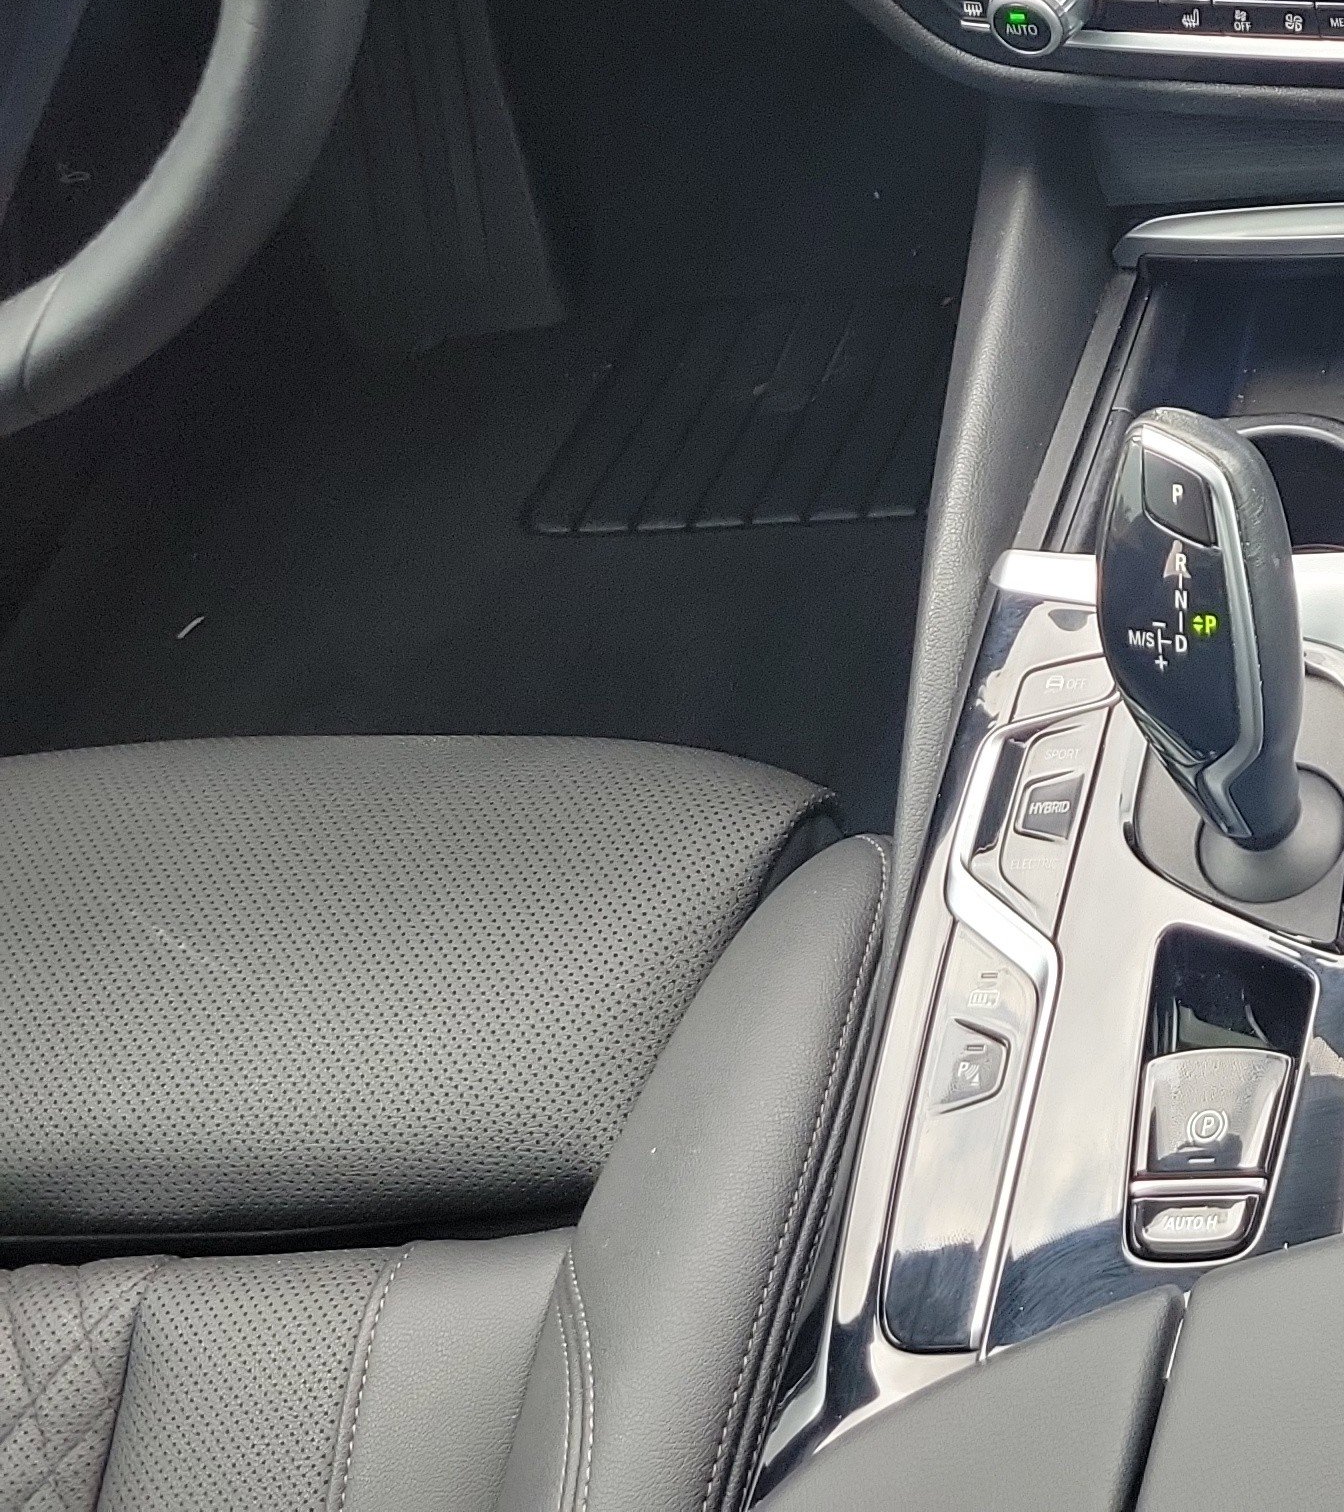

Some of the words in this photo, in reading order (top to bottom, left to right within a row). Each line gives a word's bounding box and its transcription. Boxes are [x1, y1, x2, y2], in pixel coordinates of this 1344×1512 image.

[1006, 23, 1038, 37] AUTO
[1233, 20, 1252, 32] OFF
[1172, 483, 1184, 506] P
[1175, 552, 1188, 574] R
[1174, 589, 1188, 611] N
[1205, 614, 1218, 637] P
[1127, 628, 1155, 649] M/S
[1175, 634, 1188, 654] D
[1066, 677, 1087, 689] OFF
[1044, 748, 1081, 760] SPORT
[1028, 799, 1071, 815] HYBRID
[1163, 1214, 1202, 1232] AUTO
[1204, 1214, 1218, 1231] H
